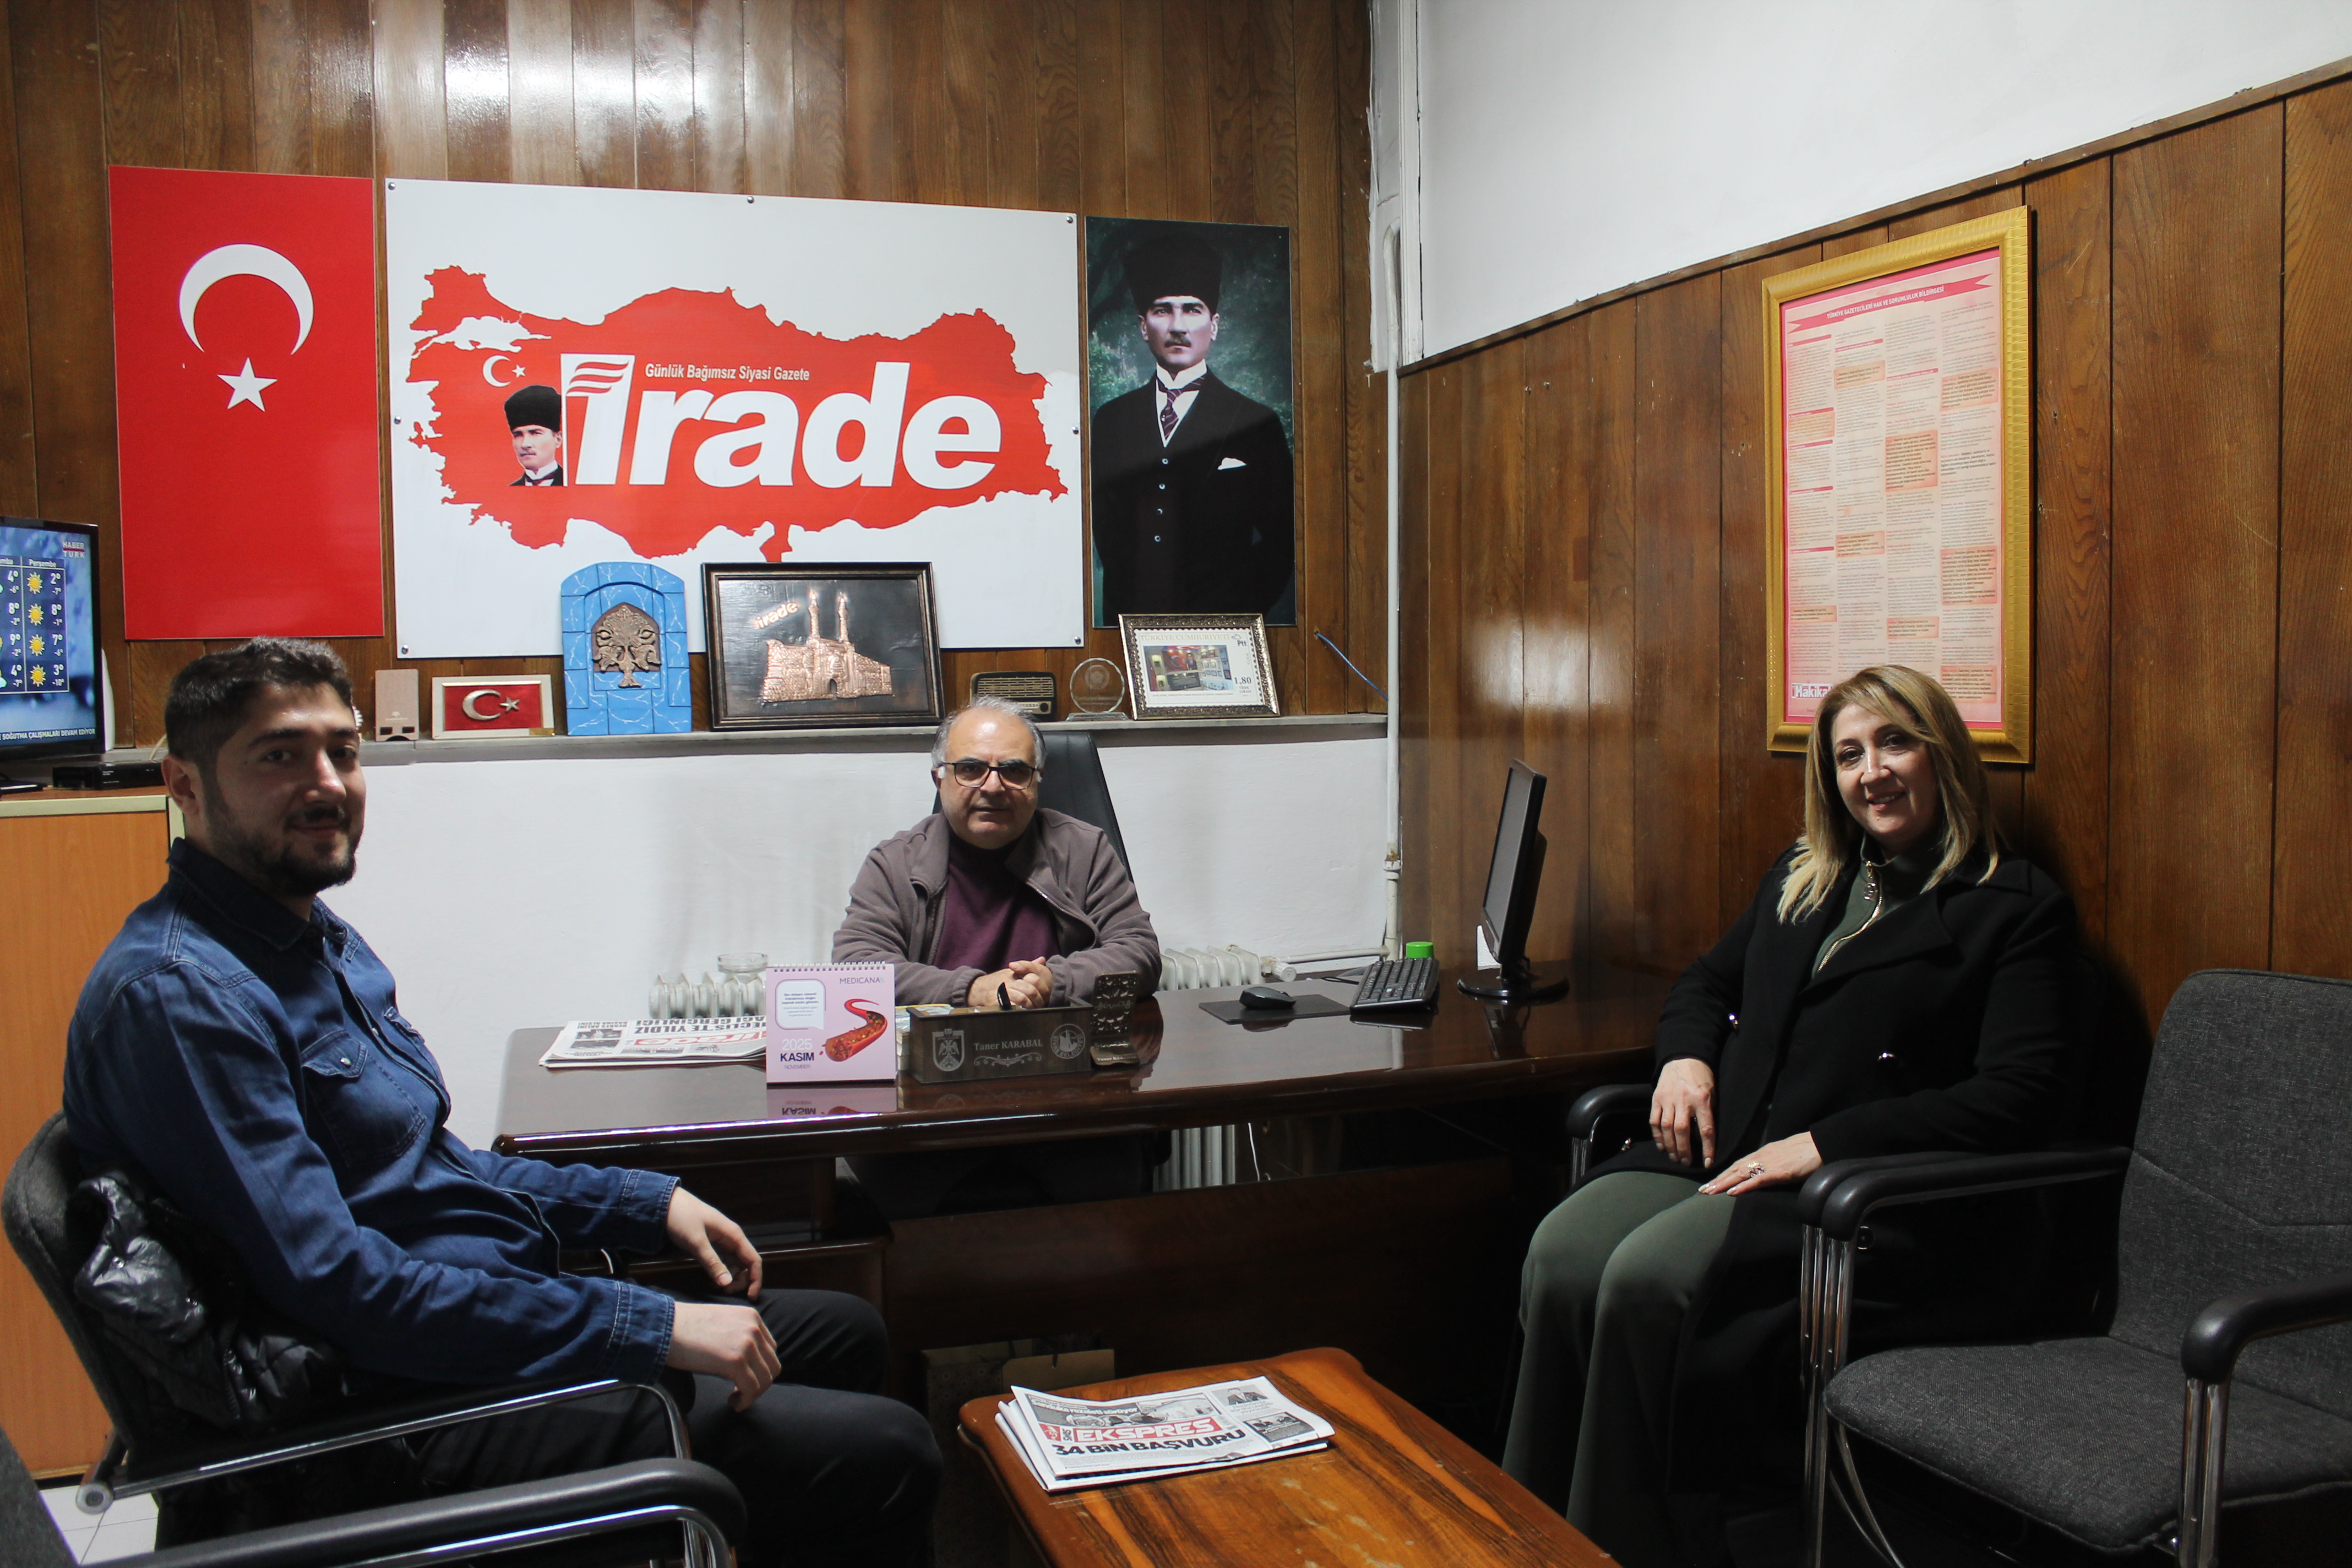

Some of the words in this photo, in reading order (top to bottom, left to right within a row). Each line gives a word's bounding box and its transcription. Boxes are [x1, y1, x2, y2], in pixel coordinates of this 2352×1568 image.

[1827, 309, 1844, 319] TÜRKİYE
[1888, 293, 1918, 304] SORUMLULUK
[1919, 285, 1945, 297] BİLDİRGESİ
[645, 363, 684, 378] Günlük
[687, 364, 737, 382] Bağımsız
[739, 366, 771, 383] Siyasi
[774, 366, 809, 381] Gazete
[63, 541, 85, 549] HABER
[1234, 677, 1252, 685] 1,80
[79, 727, 95, 736] EDİYOR
[634, 1025, 687, 1034] YILDIZ
[782, 1038, 812, 1050] 2025
[973, 1042, 999, 1050] Taner
[1001, 1039, 1043, 1049] KARABAL
[780, 1052, 814, 1061] KASIM
[1077, 1419, 1215, 1442] EKSPRES
[1052, 1444, 1086, 1455] 34
[1130, 1430, 1246, 1451] BAŞVURU
